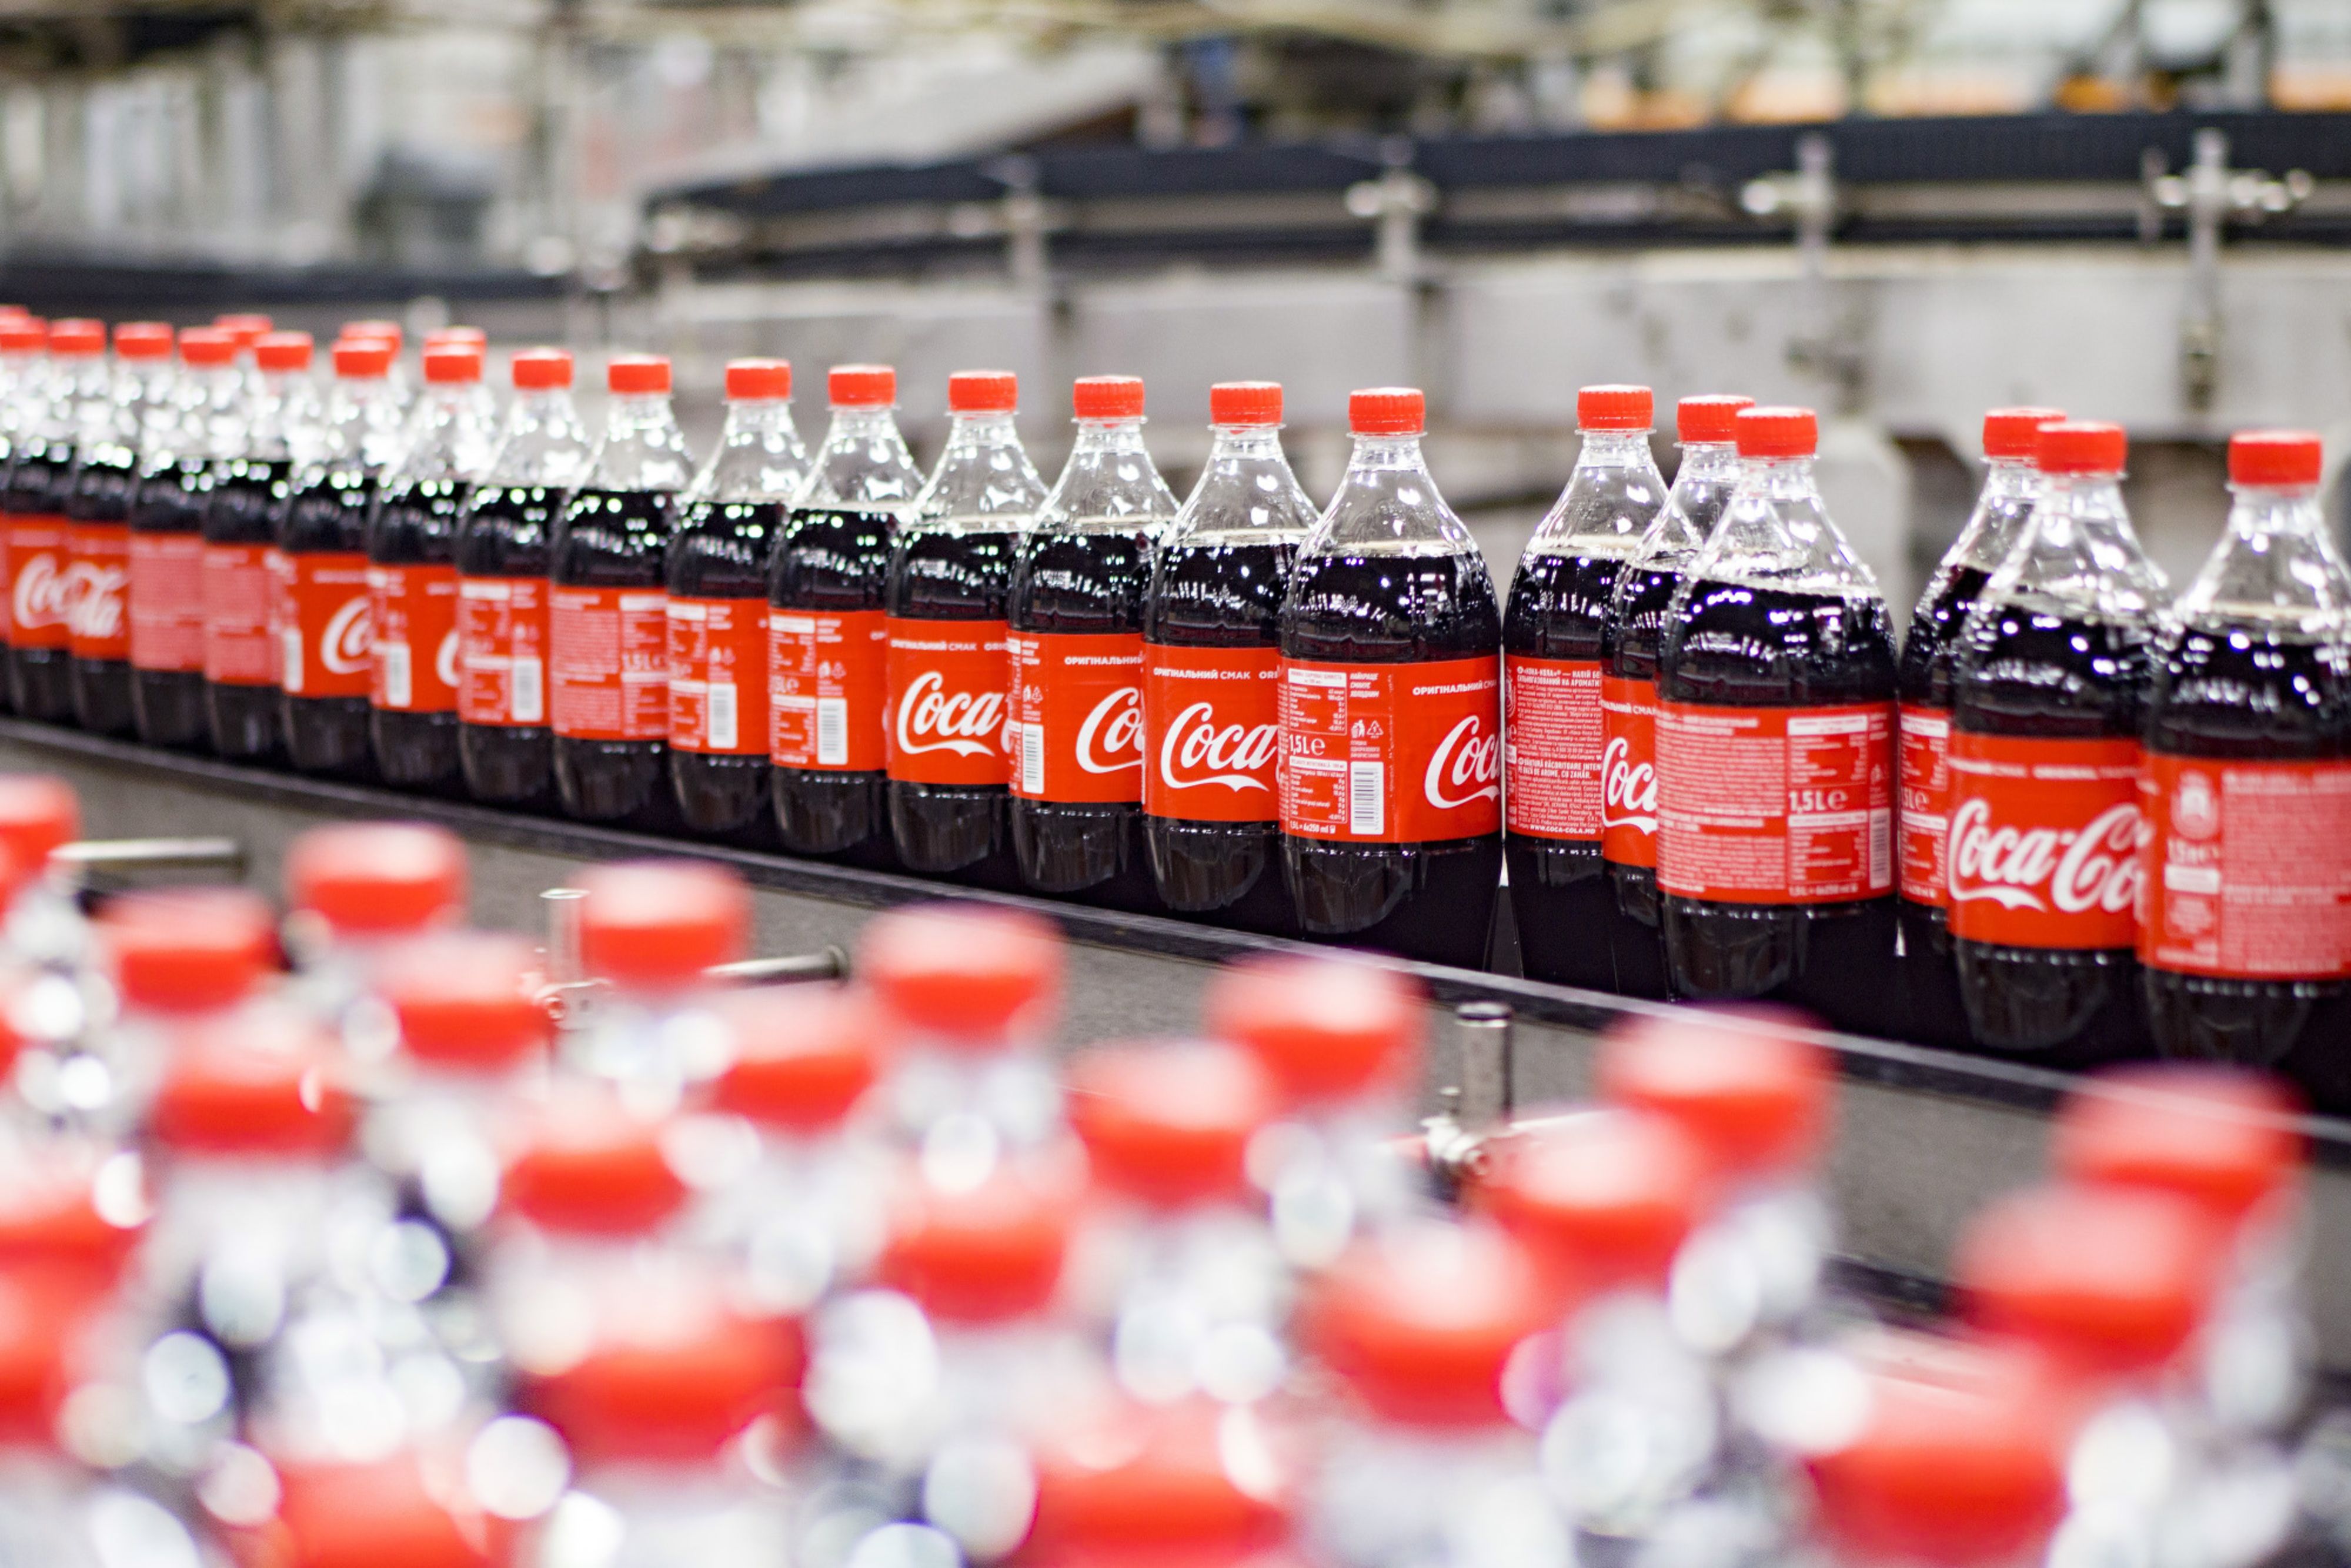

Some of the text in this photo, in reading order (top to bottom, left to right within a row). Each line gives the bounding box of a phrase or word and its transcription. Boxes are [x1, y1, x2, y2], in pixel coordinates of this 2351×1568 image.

[1220, 671, 1251, 680] СМАК
[1412, 680, 1483, 696] ОРИГІНАЛЬНИЙ
[897, 671, 1004, 757] Coca
[1161, 702, 1278, 793] Coca
